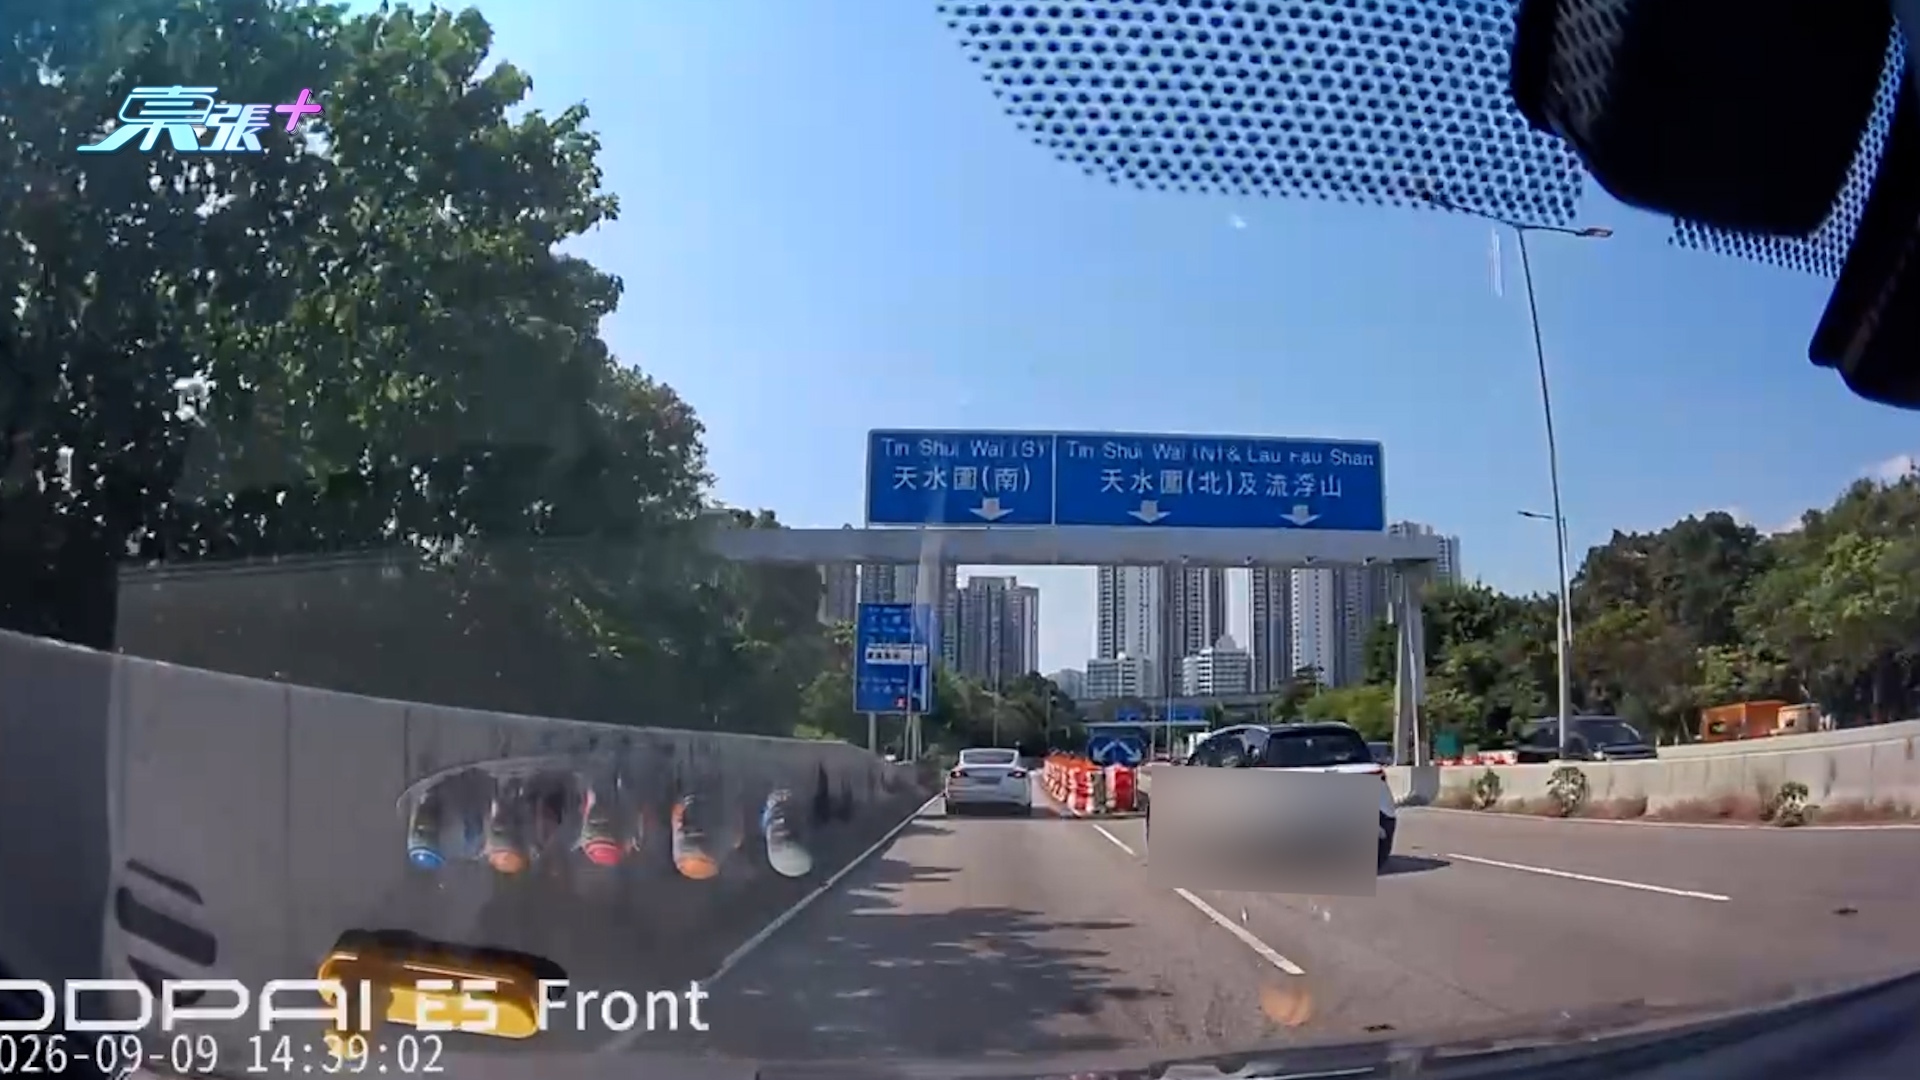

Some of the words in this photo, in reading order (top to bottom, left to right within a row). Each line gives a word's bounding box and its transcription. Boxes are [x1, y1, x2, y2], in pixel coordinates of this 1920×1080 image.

[881, 438, 909, 456] Tin
[919, 438, 959, 457] Shui
[970, 440, 1004, 457] Wai
[1066, 440, 1094, 458] Tin
[1103, 441, 1142, 459] Shui
[1153, 443, 1186, 460] Wai
[1248, 446, 1281, 464] Lau
[1330, 448, 1374, 466] Shan
